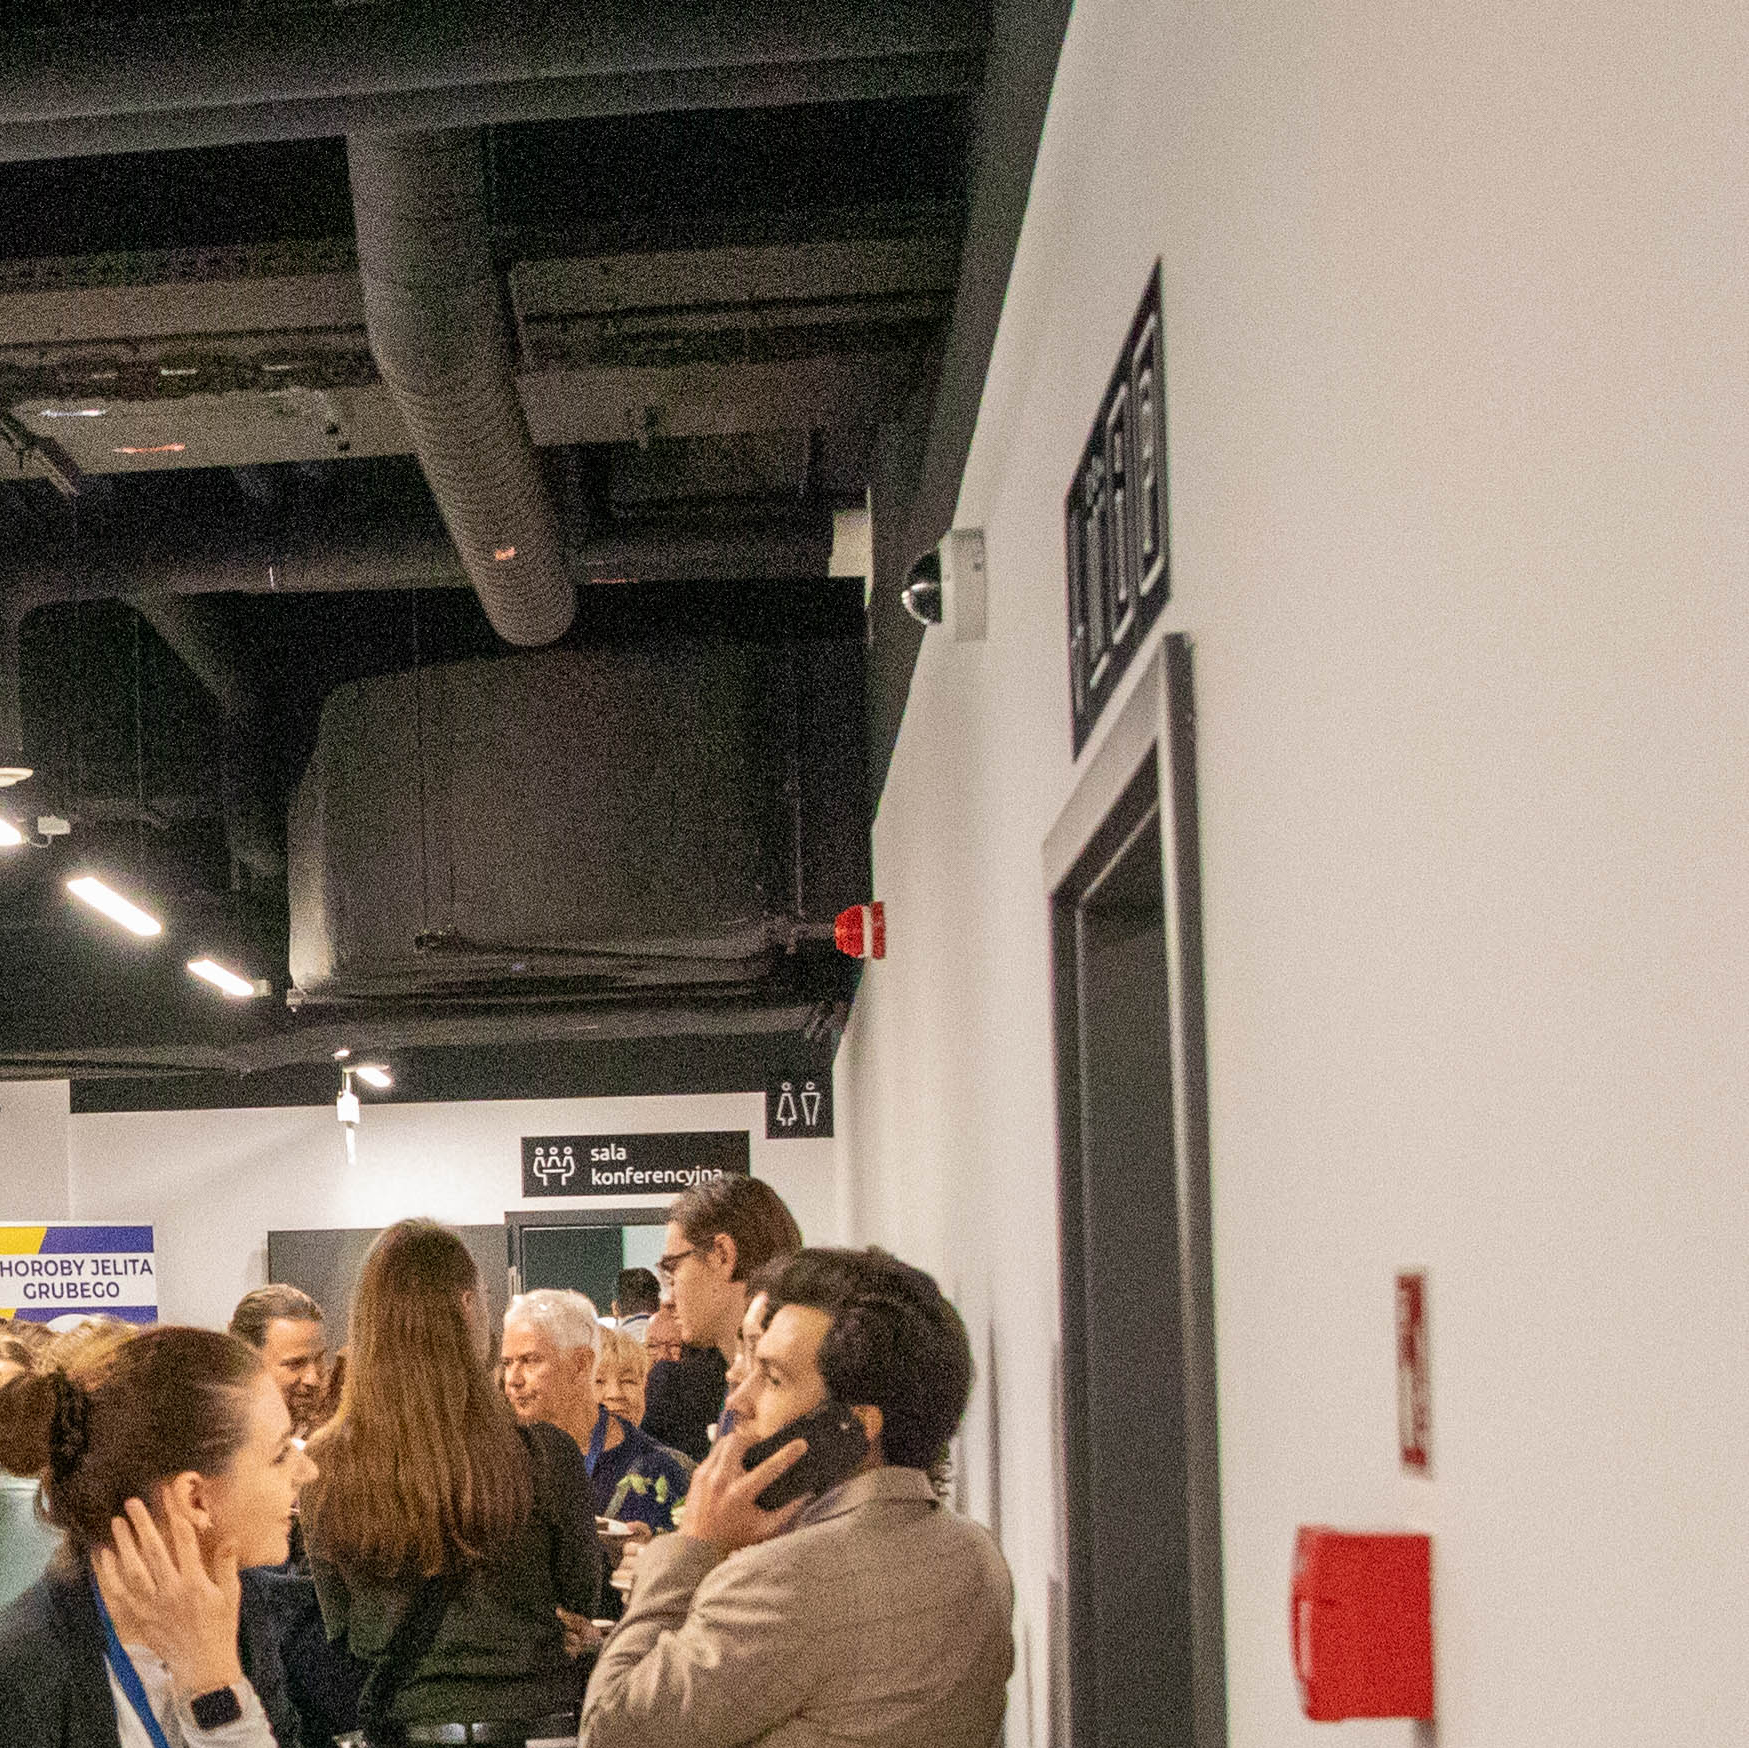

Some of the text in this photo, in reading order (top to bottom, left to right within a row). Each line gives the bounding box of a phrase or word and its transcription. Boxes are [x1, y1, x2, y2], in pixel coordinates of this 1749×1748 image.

[590, 1143, 627, 1161] sala
[591, 1165, 723, 1187] konferencyjna
[90, 1258, 153, 1276] JELITA
[22, 1281, 120, 1299] GRUBEGO
